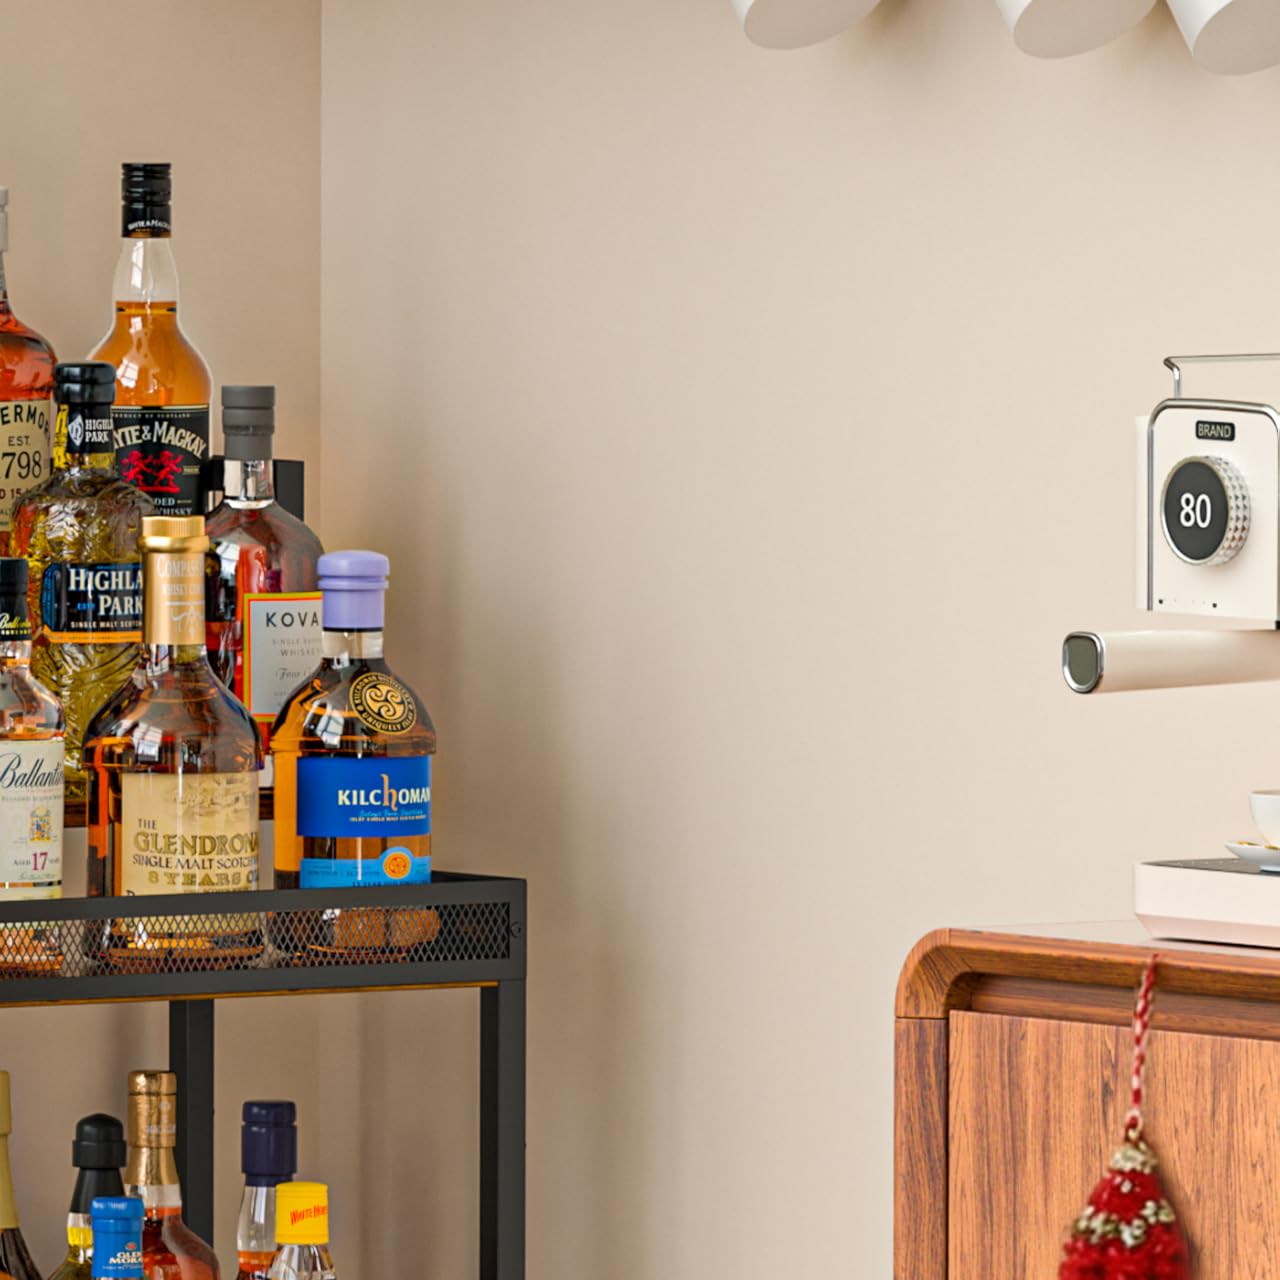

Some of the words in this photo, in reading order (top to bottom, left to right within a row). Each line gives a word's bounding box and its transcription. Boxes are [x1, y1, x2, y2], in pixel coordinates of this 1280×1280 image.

[84, 430, 109, 443] PARK
[1198, 422, 1232, 439] BRAND
[153, 420, 207, 460] MACKAY
[1179, 492, 1212, 529] 80
[70, 620, 97, 629] SINGLE
[99, 620, 117, 629] MALT
[137, 818, 158, 830] THE
[32, 851, 50, 872] 17
[132, 854, 173, 869] SINGLE
[175, 858, 213, 870] MALT
[147, 870, 159, 884] 8
[163, 871, 242, 886] YEARS
